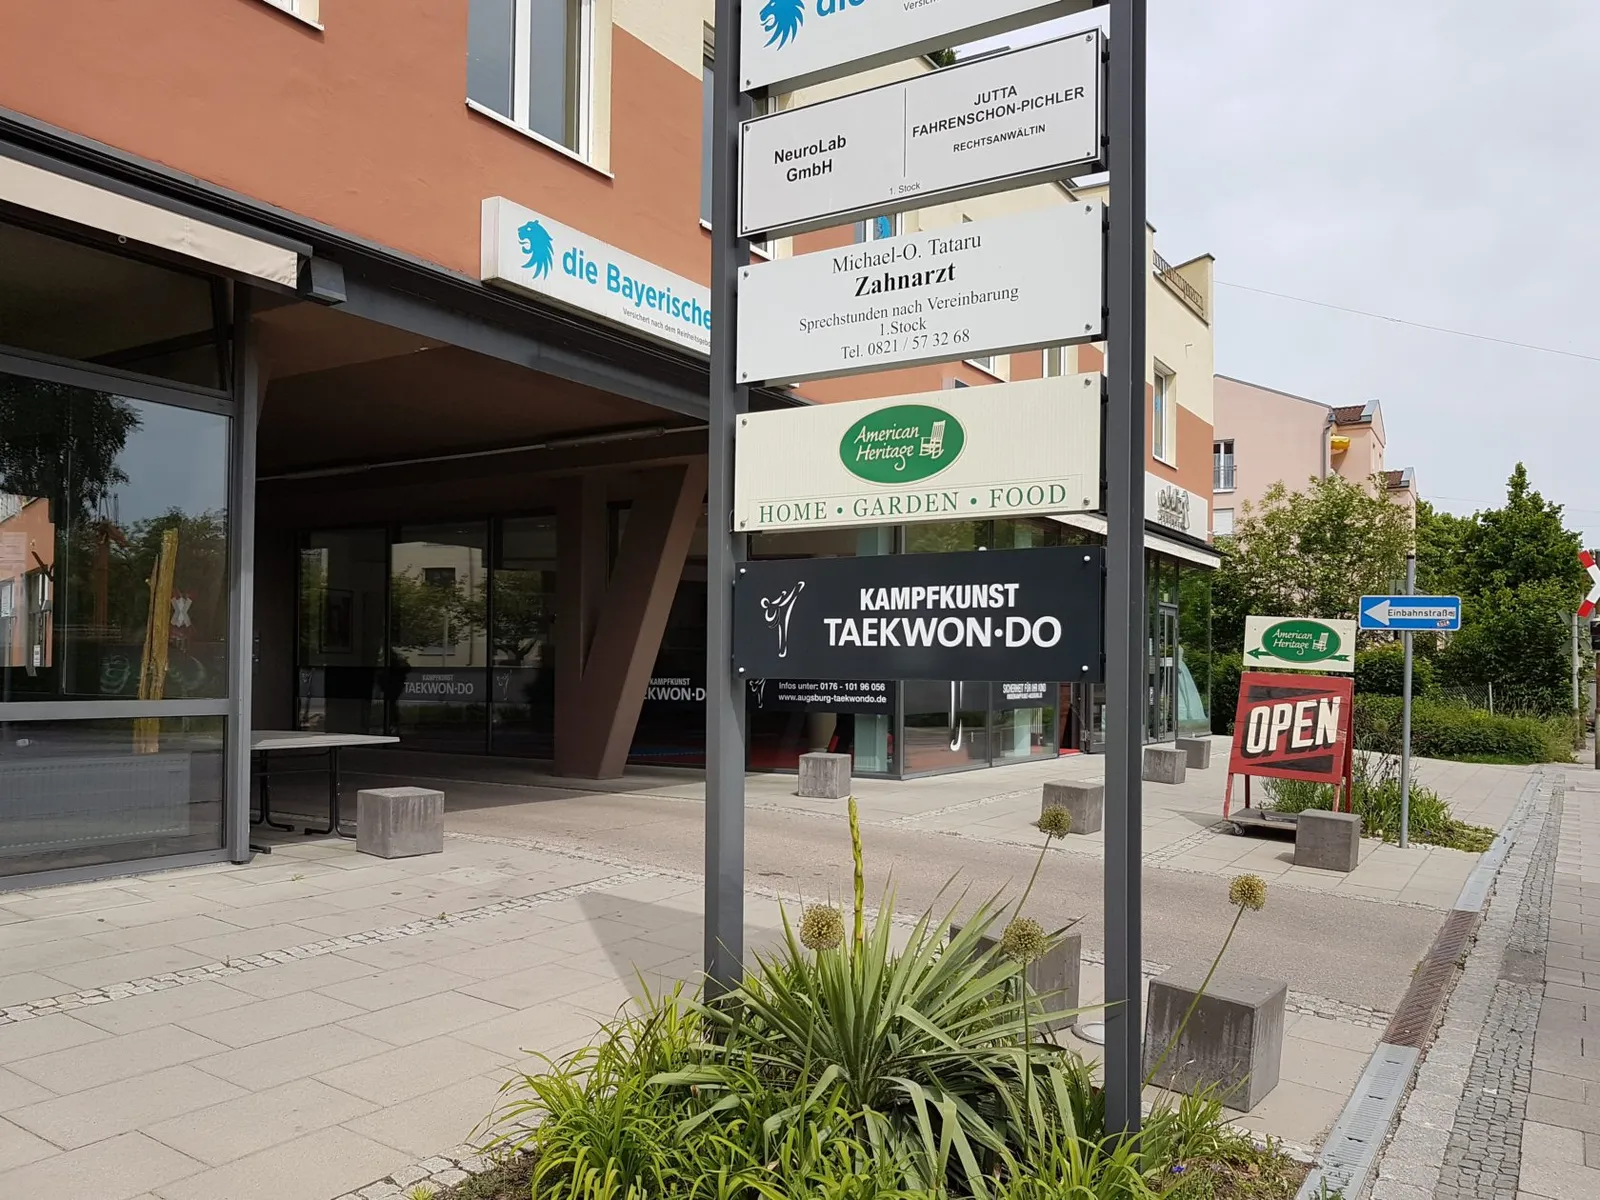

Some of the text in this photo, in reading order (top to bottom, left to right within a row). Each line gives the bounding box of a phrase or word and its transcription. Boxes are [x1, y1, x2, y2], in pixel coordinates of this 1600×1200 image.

[974, 85, 1018, 106] JUTTA
[912, 86, 1085, 138] FAHRENSCHON-PICHLER
[774, 135, 847, 164] NeuroLab
[953, 124, 1046, 152] RECHTSANWÄLTIN
[786, 159, 832, 182] GmbH
[889, 181, 921, 195] 1. Stock
[832, 235, 981, 274] Michael-O. Tataru
[562, 247, 711, 331] die Bayerische
[854, 262, 956, 297] Zahnarzt
[622, 306, 650, 325] Versichert
[650, 318, 664, 329] nach
[664, 323, 676, 334] dem
[799, 287, 1019, 334] Sprechstunden nach Vereinbarung
[841, 345, 863, 359] Tel.
[867, 339, 898, 356] 0821
[912, 335, 928, 350] 57
[932, 331, 949, 347] 32
[953, 329, 970, 343] 68
[854, 423, 920, 444] American
[856, 442, 914, 471] Heritage
[759, 483, 1067, 524] HOME GARDEN FOOD
[860, 583, 1020, 611] KAMPFKUNST
[1272, 629, 1313, 640] American
[1272, 638, 1310, 656] Heritage
[649, 678, 691, 686] KAMPFKUNST
[778, 682, 796, 690] Infos
[798, 682, 819, 690] unter:
[820, 682, 838, 691] 0176
[845, 683, 858, 691] 101
[860, 683, 870, 691] 96
[871, 683, 886, 691] 056
[778, 694, 887, 704] www.augsburg-taekwondo.de
[1246, 696, 1341, 754] OPEN
